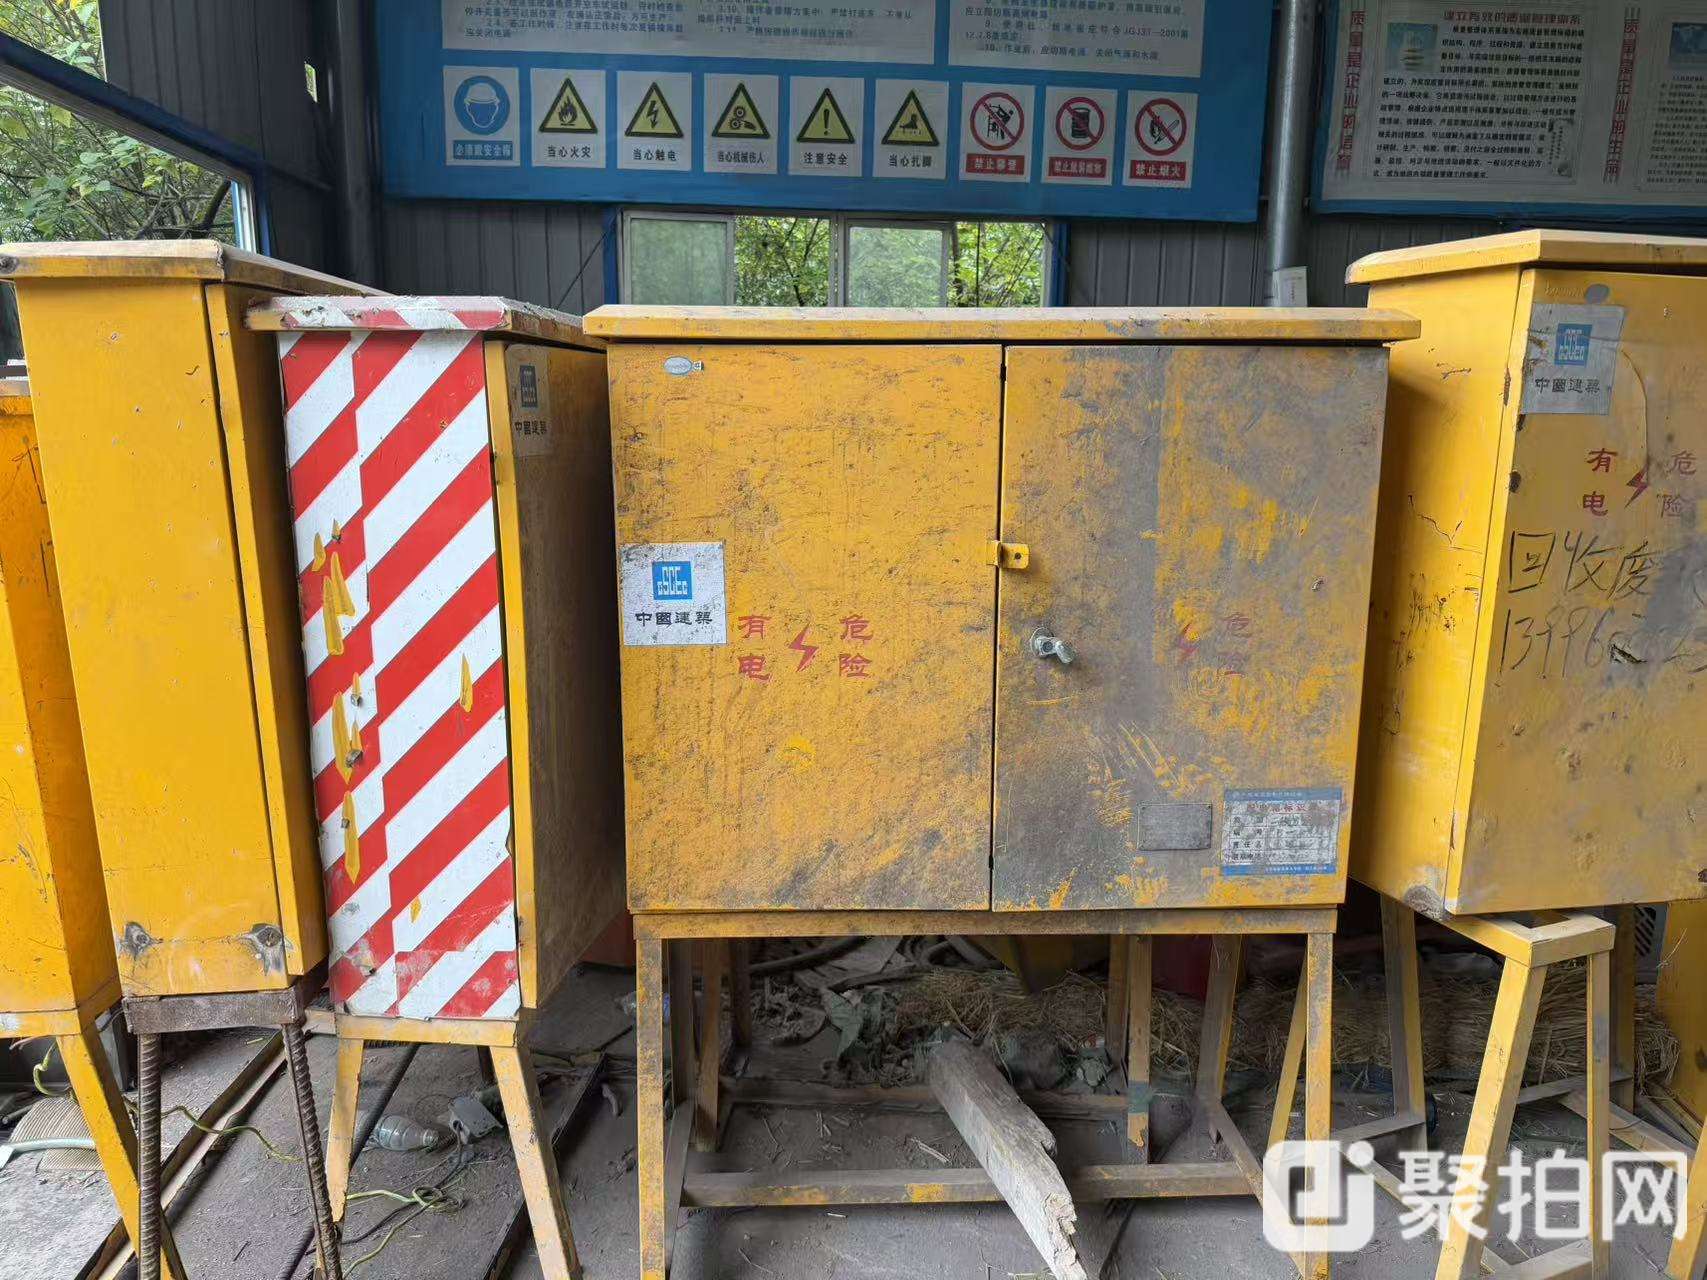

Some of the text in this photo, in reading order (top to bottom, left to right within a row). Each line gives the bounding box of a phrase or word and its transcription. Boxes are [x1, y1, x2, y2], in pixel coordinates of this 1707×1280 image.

[547, 144, 593, 159] 当心火灾
[633, 148, 678, 162] 当心触电
[717, 151, 766, 165] 当心机械伤人
[803, 152, 849, 166] 注意安全
[888, 154, 933, 168] 当心扎脚
[1136, 163, 1183, 177] 禁止烟火
